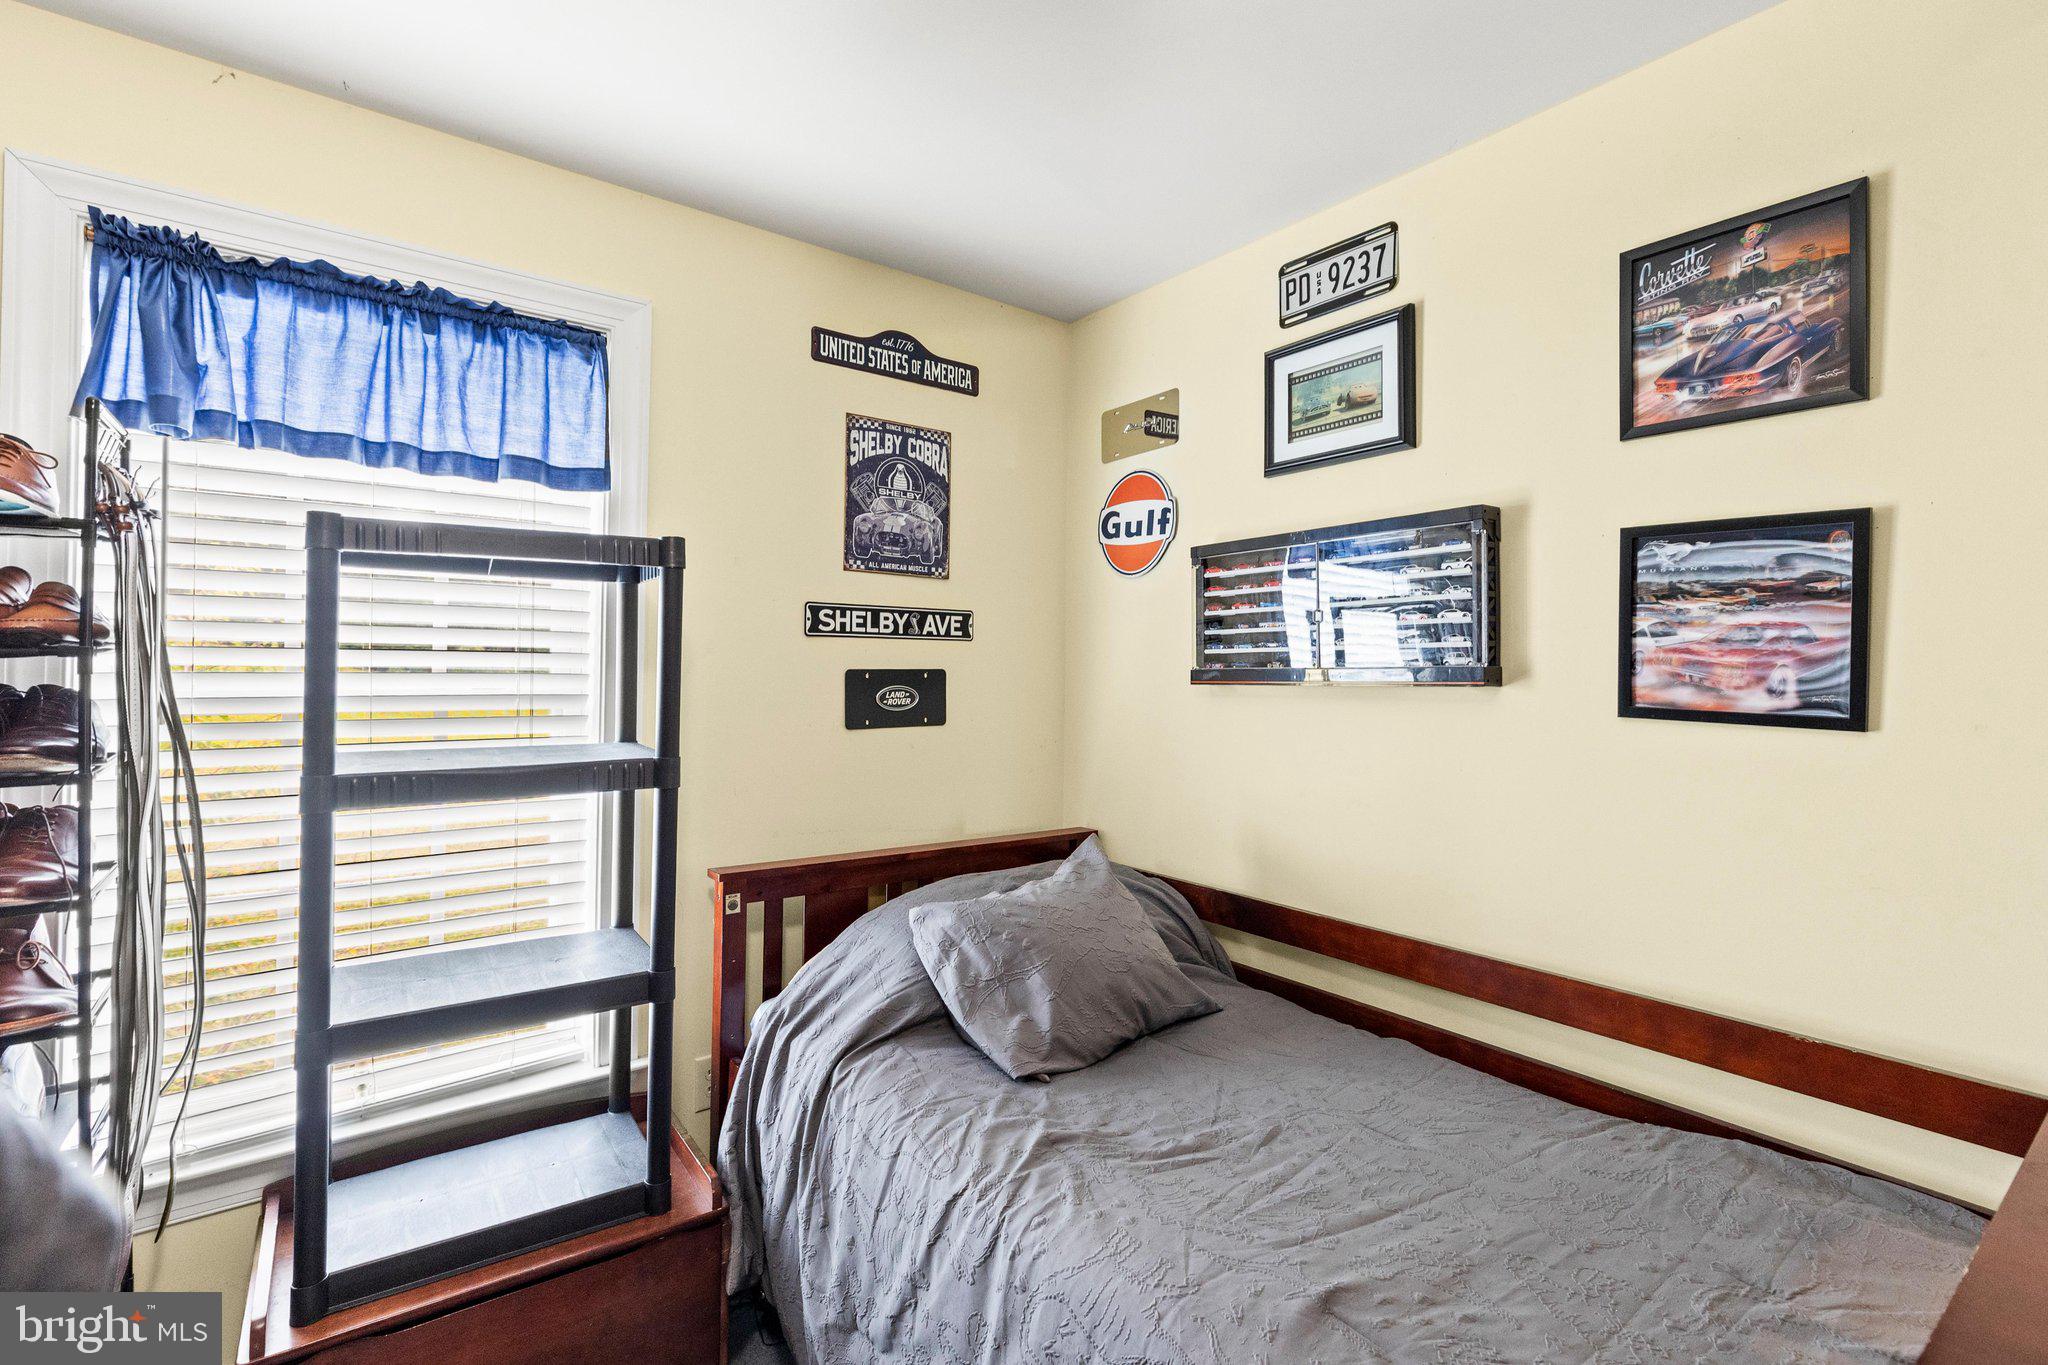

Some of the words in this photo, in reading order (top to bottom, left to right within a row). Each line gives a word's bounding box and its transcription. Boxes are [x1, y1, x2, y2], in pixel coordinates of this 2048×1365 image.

[1285, 272, 1311, 311] PD
[1327, 242, 1387, 294] 9237
[1638, 243, 1716, 297] Corvette
[881, 337, 896, 349] est.
[895, 338, 914, 353] 1776
[819, 333, 865, 366] UNITED
[868, 346, 909, 375] STATES
[911, 359, 922, 375] OF
[923, 360, 973, 390] AMERICA
[886, 423, 902, 433] SINCE
[849, 429, 903, 467] SHELBY
[907, 436, 949, 483] COBRA
[878, 488, 922, 500] SHELBY
[1101, 507, 1172, 540] Gulf
[868, 561, 880, 569] ALL
[881, 562, 907, 571] AMERICAN
[908, 564, 929, 573] MUSCLE
[818, 608, 910, 635] SHELBY
[922, 614, 963, 636] AVE
